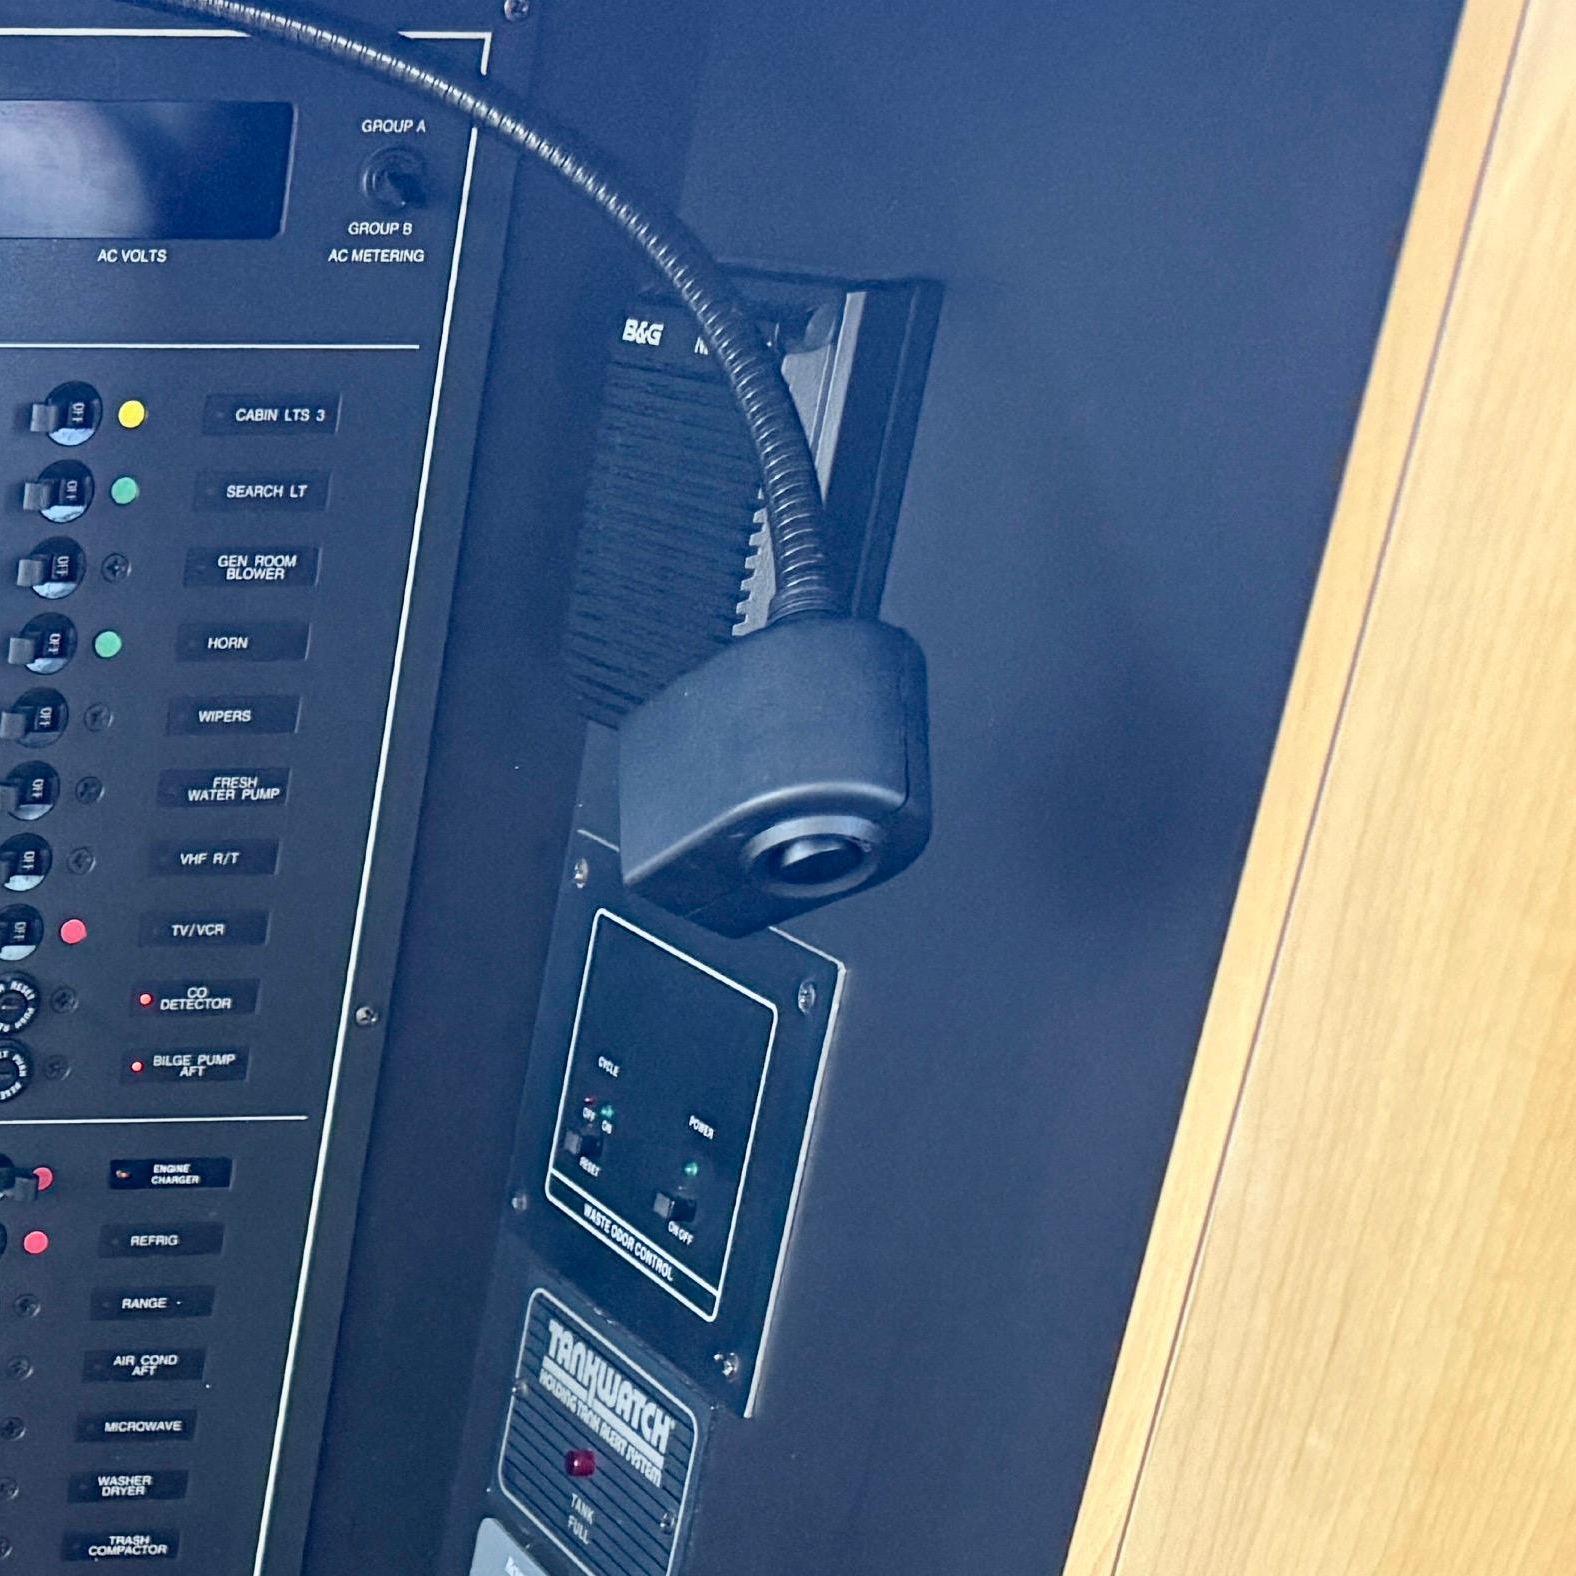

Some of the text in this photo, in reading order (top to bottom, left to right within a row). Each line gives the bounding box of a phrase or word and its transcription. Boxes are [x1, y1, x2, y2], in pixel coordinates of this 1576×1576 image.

[362, 119, 425, 132] GROUP A
[348, 222, 412, 235] GROUP B
[98, 249, 166, 262] AC VOLTS
[328, 249, 424, 262] AC METERING
[623, 319, 664, 345] B&G
[227, 485, 307, 497] SEARCH LT
[208, 637, 248, 649] HORN
[199, 710, 251, 722] WIPERS
[172, 924, 224, 936] TV/VCR
[187, 987, 207, 998] CO
[160, 996, 231, 1010] DETECTOR
[599, 1056, 619, 1077] CYCLE
[689, 1115, 714, 1139] POWER
[154, 1164, 190, 1173] ENGINE
[151, 1175, 199, 1184] CHARGER
[131, 1235, 178, 1246] REFRIG
[584, 1204, 673, 1281] WASTE ODOR CONTROL
[122, 1298, 167, 1308] RANGE
[105, 1421, 181, 1432] MICROWAVE
[571, 1494, 593, 1524] TANK
[568, 1515, 589, 1544] FULL
